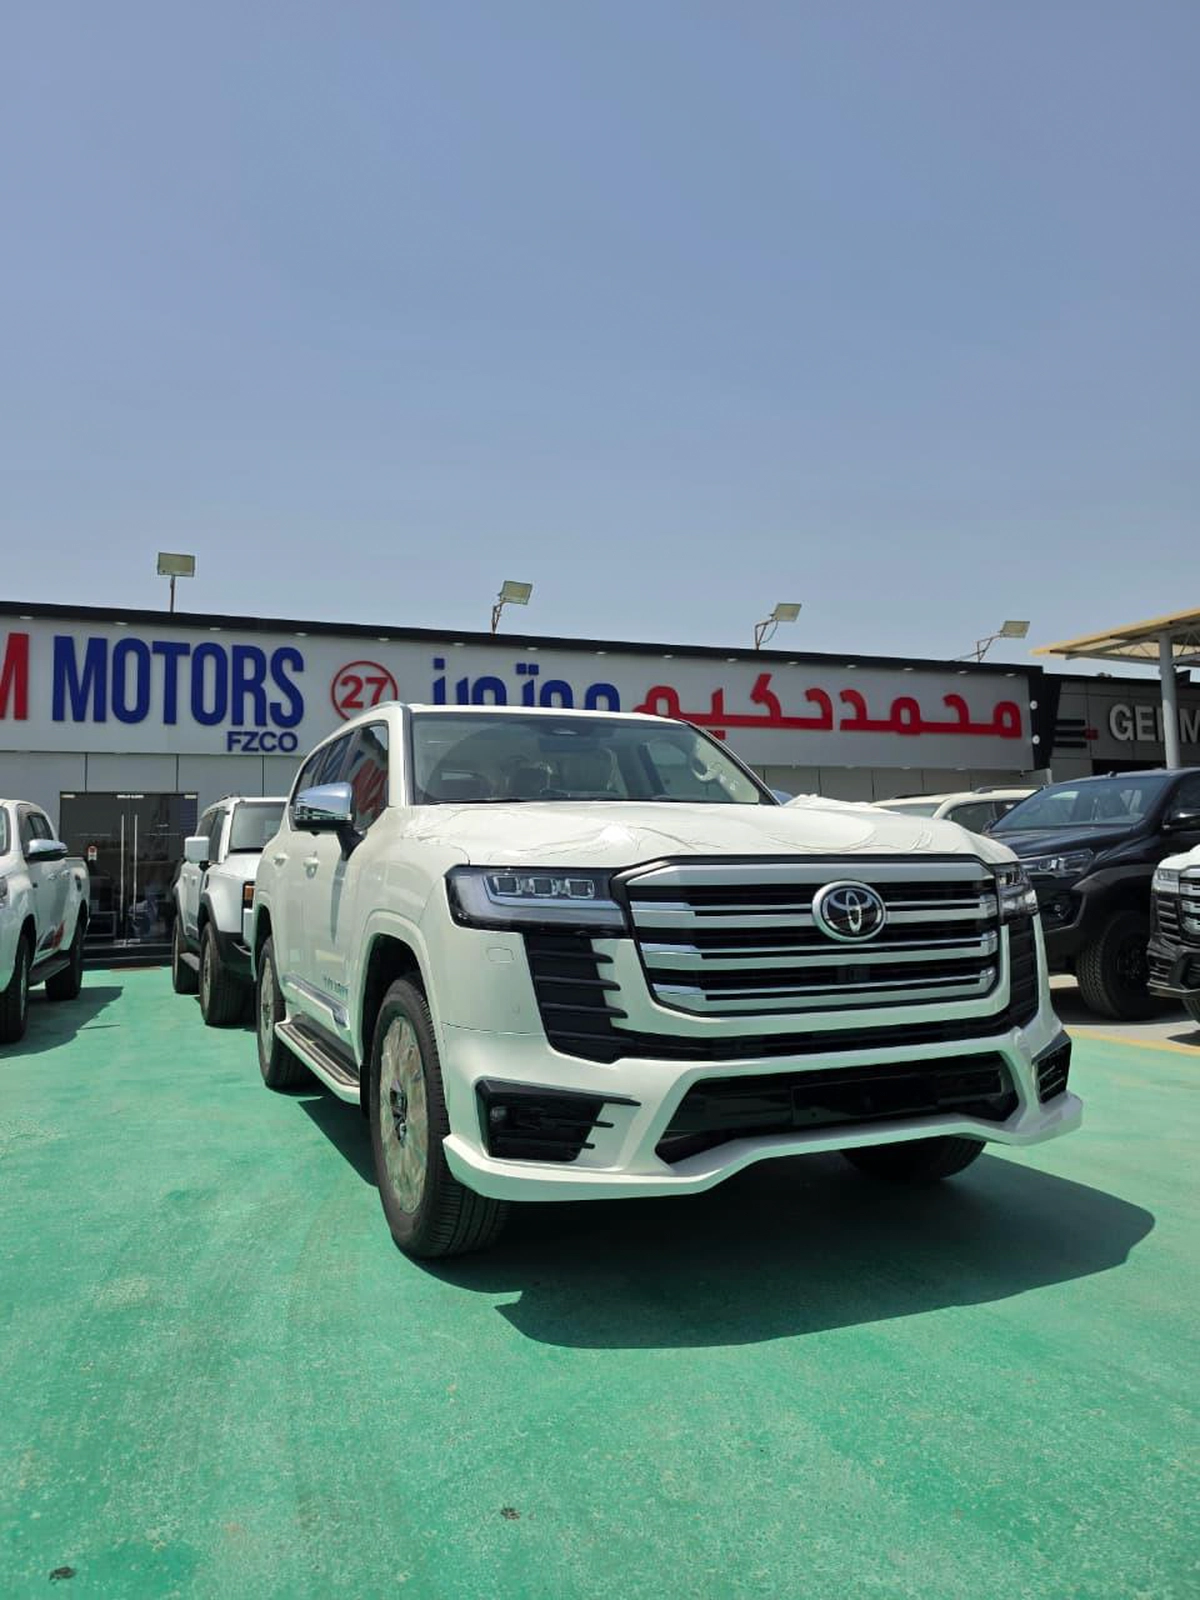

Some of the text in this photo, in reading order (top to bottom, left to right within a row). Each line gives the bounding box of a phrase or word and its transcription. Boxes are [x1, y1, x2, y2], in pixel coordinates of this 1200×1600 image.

[51, 634, 304, 728] MOTORS
[340, 676, 389, 709] 27
[839, 688, 1023, 739] محمد
[1108, 703, 1200, 743] GEM
[226, 731, 299, 753] FZCO
